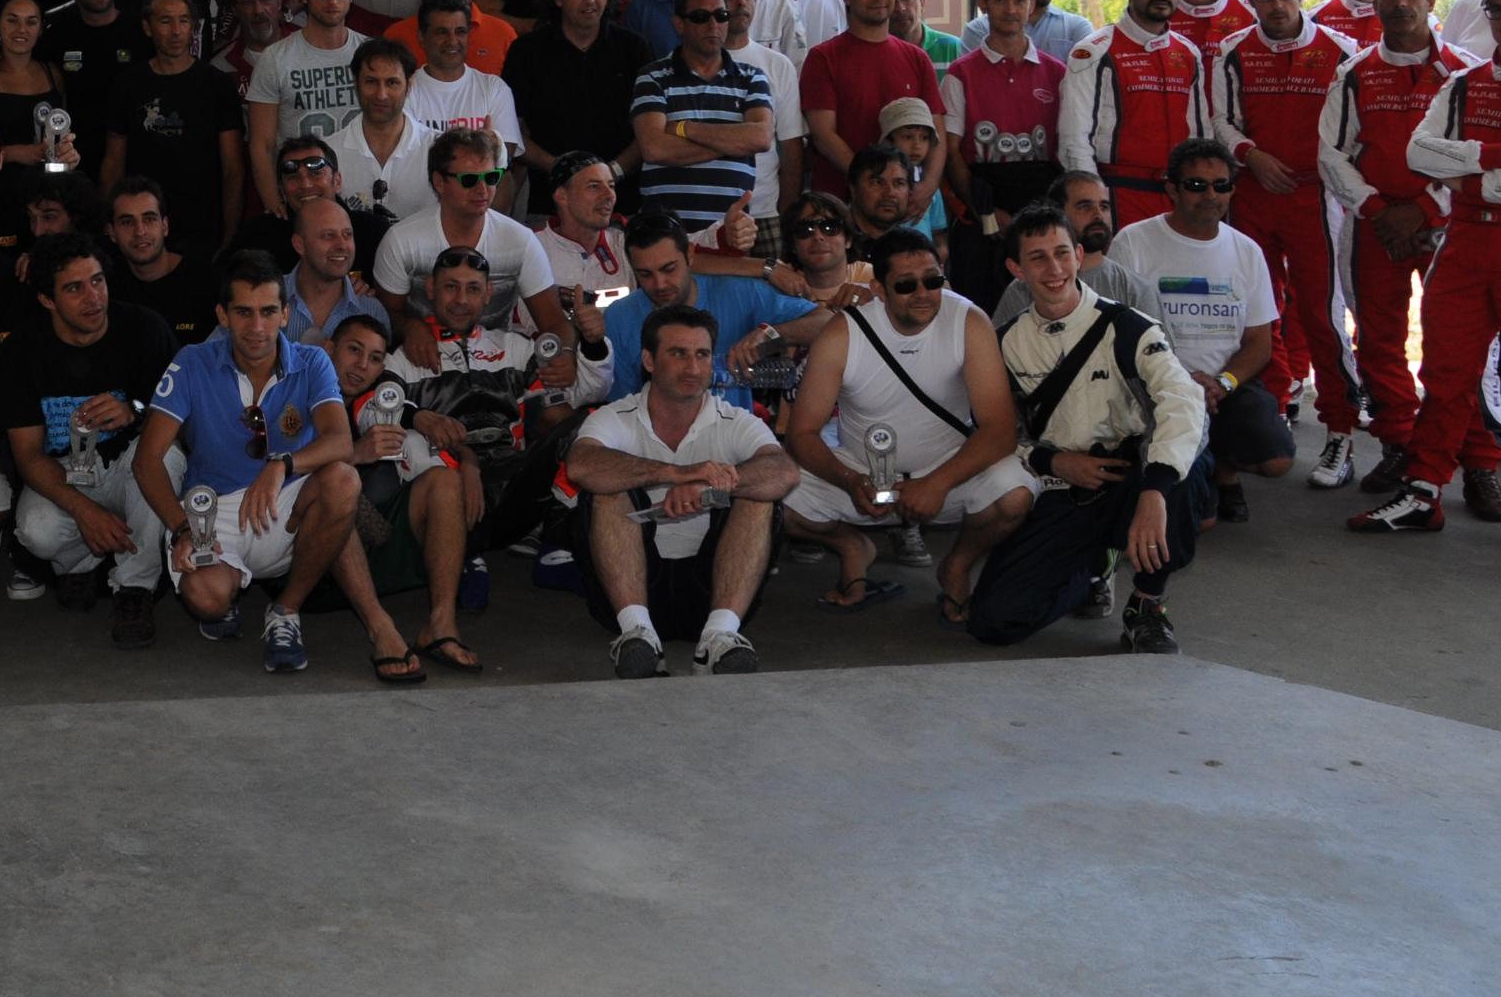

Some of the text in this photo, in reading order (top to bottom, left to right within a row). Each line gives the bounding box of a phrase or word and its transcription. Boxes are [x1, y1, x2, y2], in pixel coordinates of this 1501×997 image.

[294, 86, 357, 110] ATHLET
[1163, 302, 1240, 317] uronsan
[155, 362, 181, 398] 5
